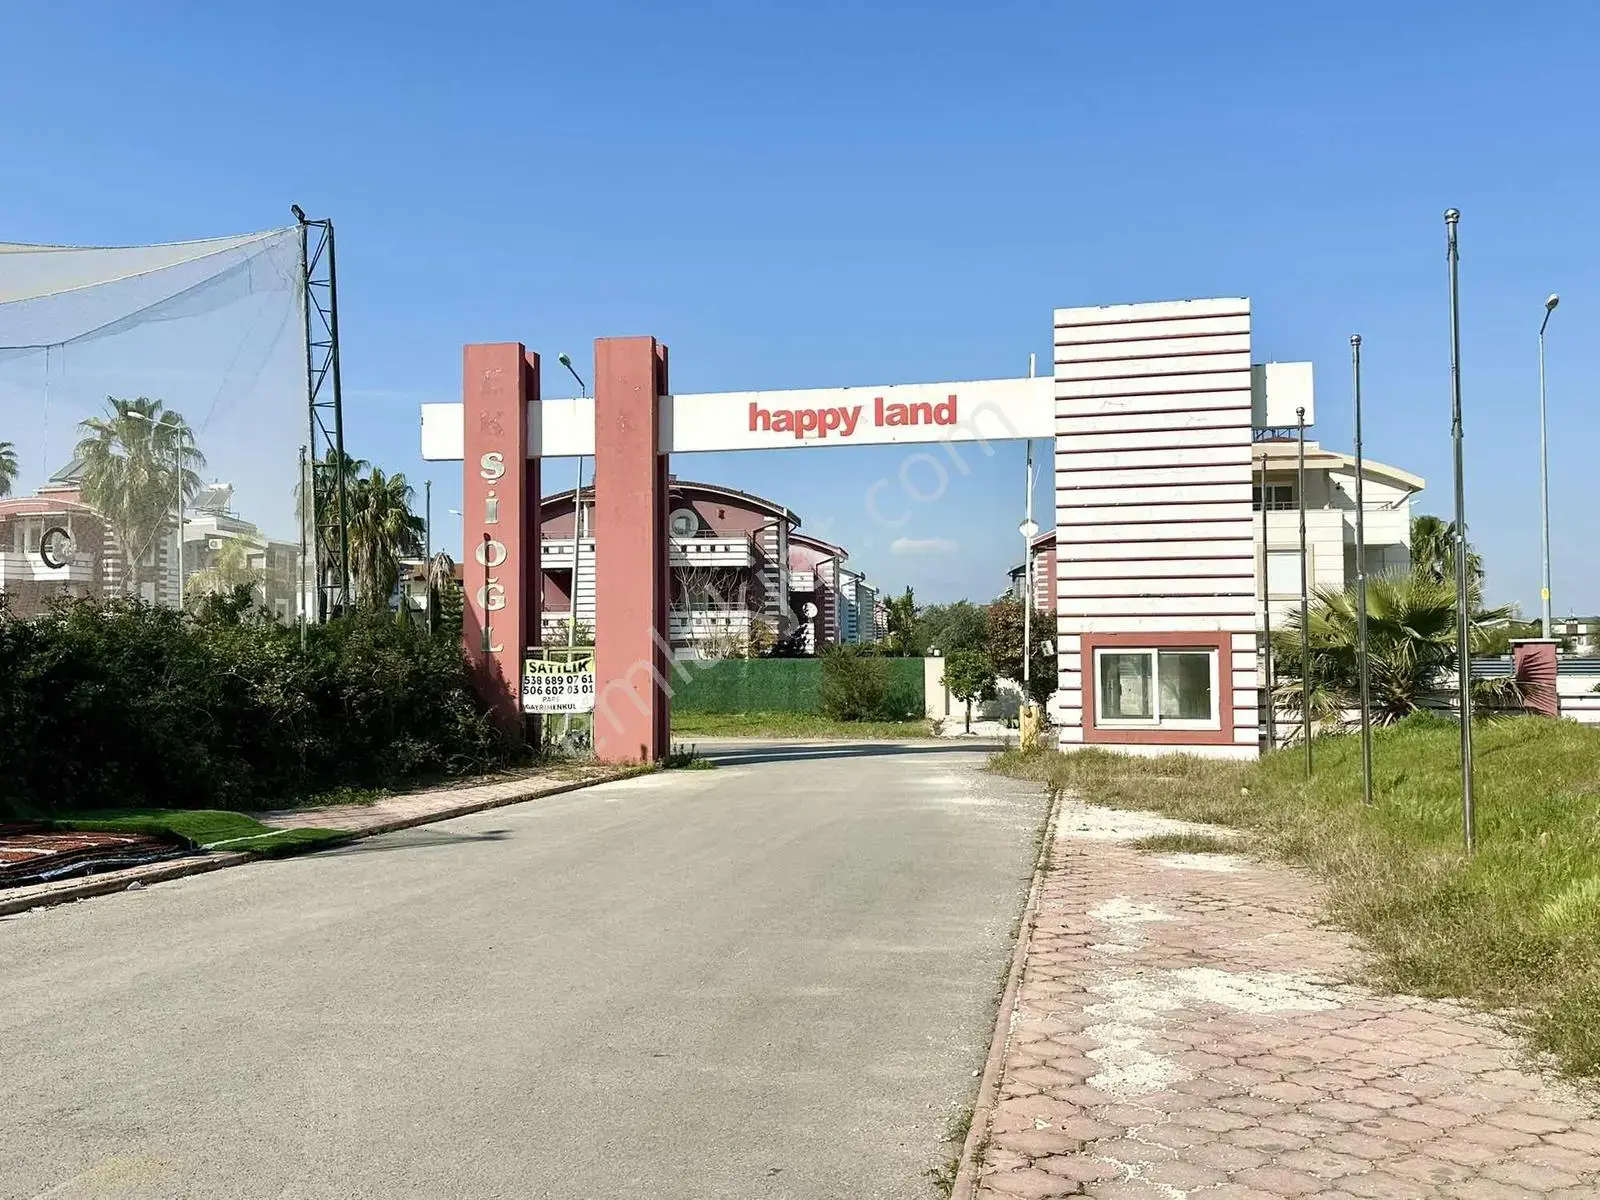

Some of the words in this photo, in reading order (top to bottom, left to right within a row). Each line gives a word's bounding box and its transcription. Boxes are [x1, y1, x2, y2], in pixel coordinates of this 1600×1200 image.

[749, 402, 864, 439] happy
[874, 394, 957, 427] land
[529, 659, 591, 673] SATILIK
[524, 675, 542, 685] 538
[545, 675, 564, 685] 689
[566, 675, 579, 685] 07
[581, 674, 593, 684] 61
[523, 686, 543, 695] 506
[545, 686, 564, 695] 602
[567, 685, 579, 694] 03
[582, 684, 593, 694] 01
